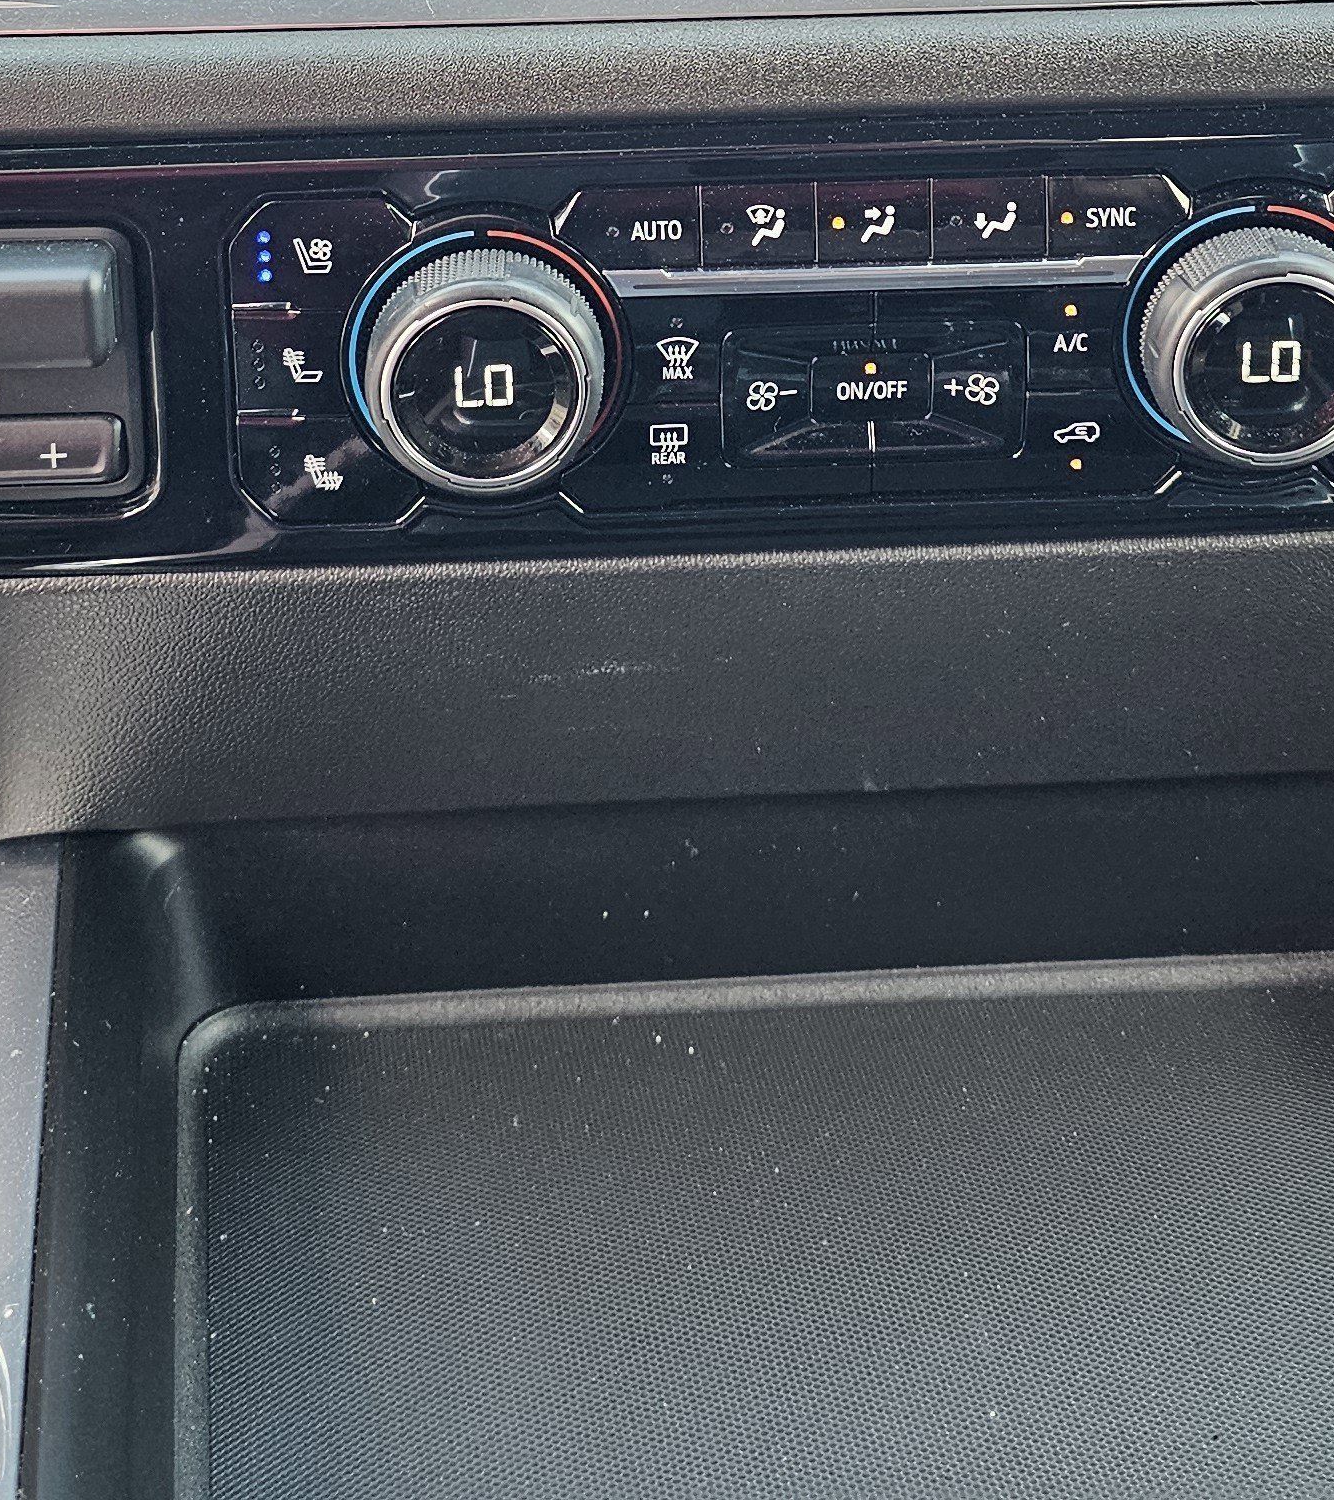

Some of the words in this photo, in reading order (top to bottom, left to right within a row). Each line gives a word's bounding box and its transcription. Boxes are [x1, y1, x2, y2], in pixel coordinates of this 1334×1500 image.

[1085, 207, 1137, 228] SYNC
[631, 219, 683, 242] AUTO
[1053, 333, 1089, 352] A/C
[661, 365, 694, 380] MAX
[1240, 341, 1301, 383] LO
[454, 364, 515, 408] LO
[836, 380, 908, 401] ON/OFF
[650, 450, 687, 465] REAR
